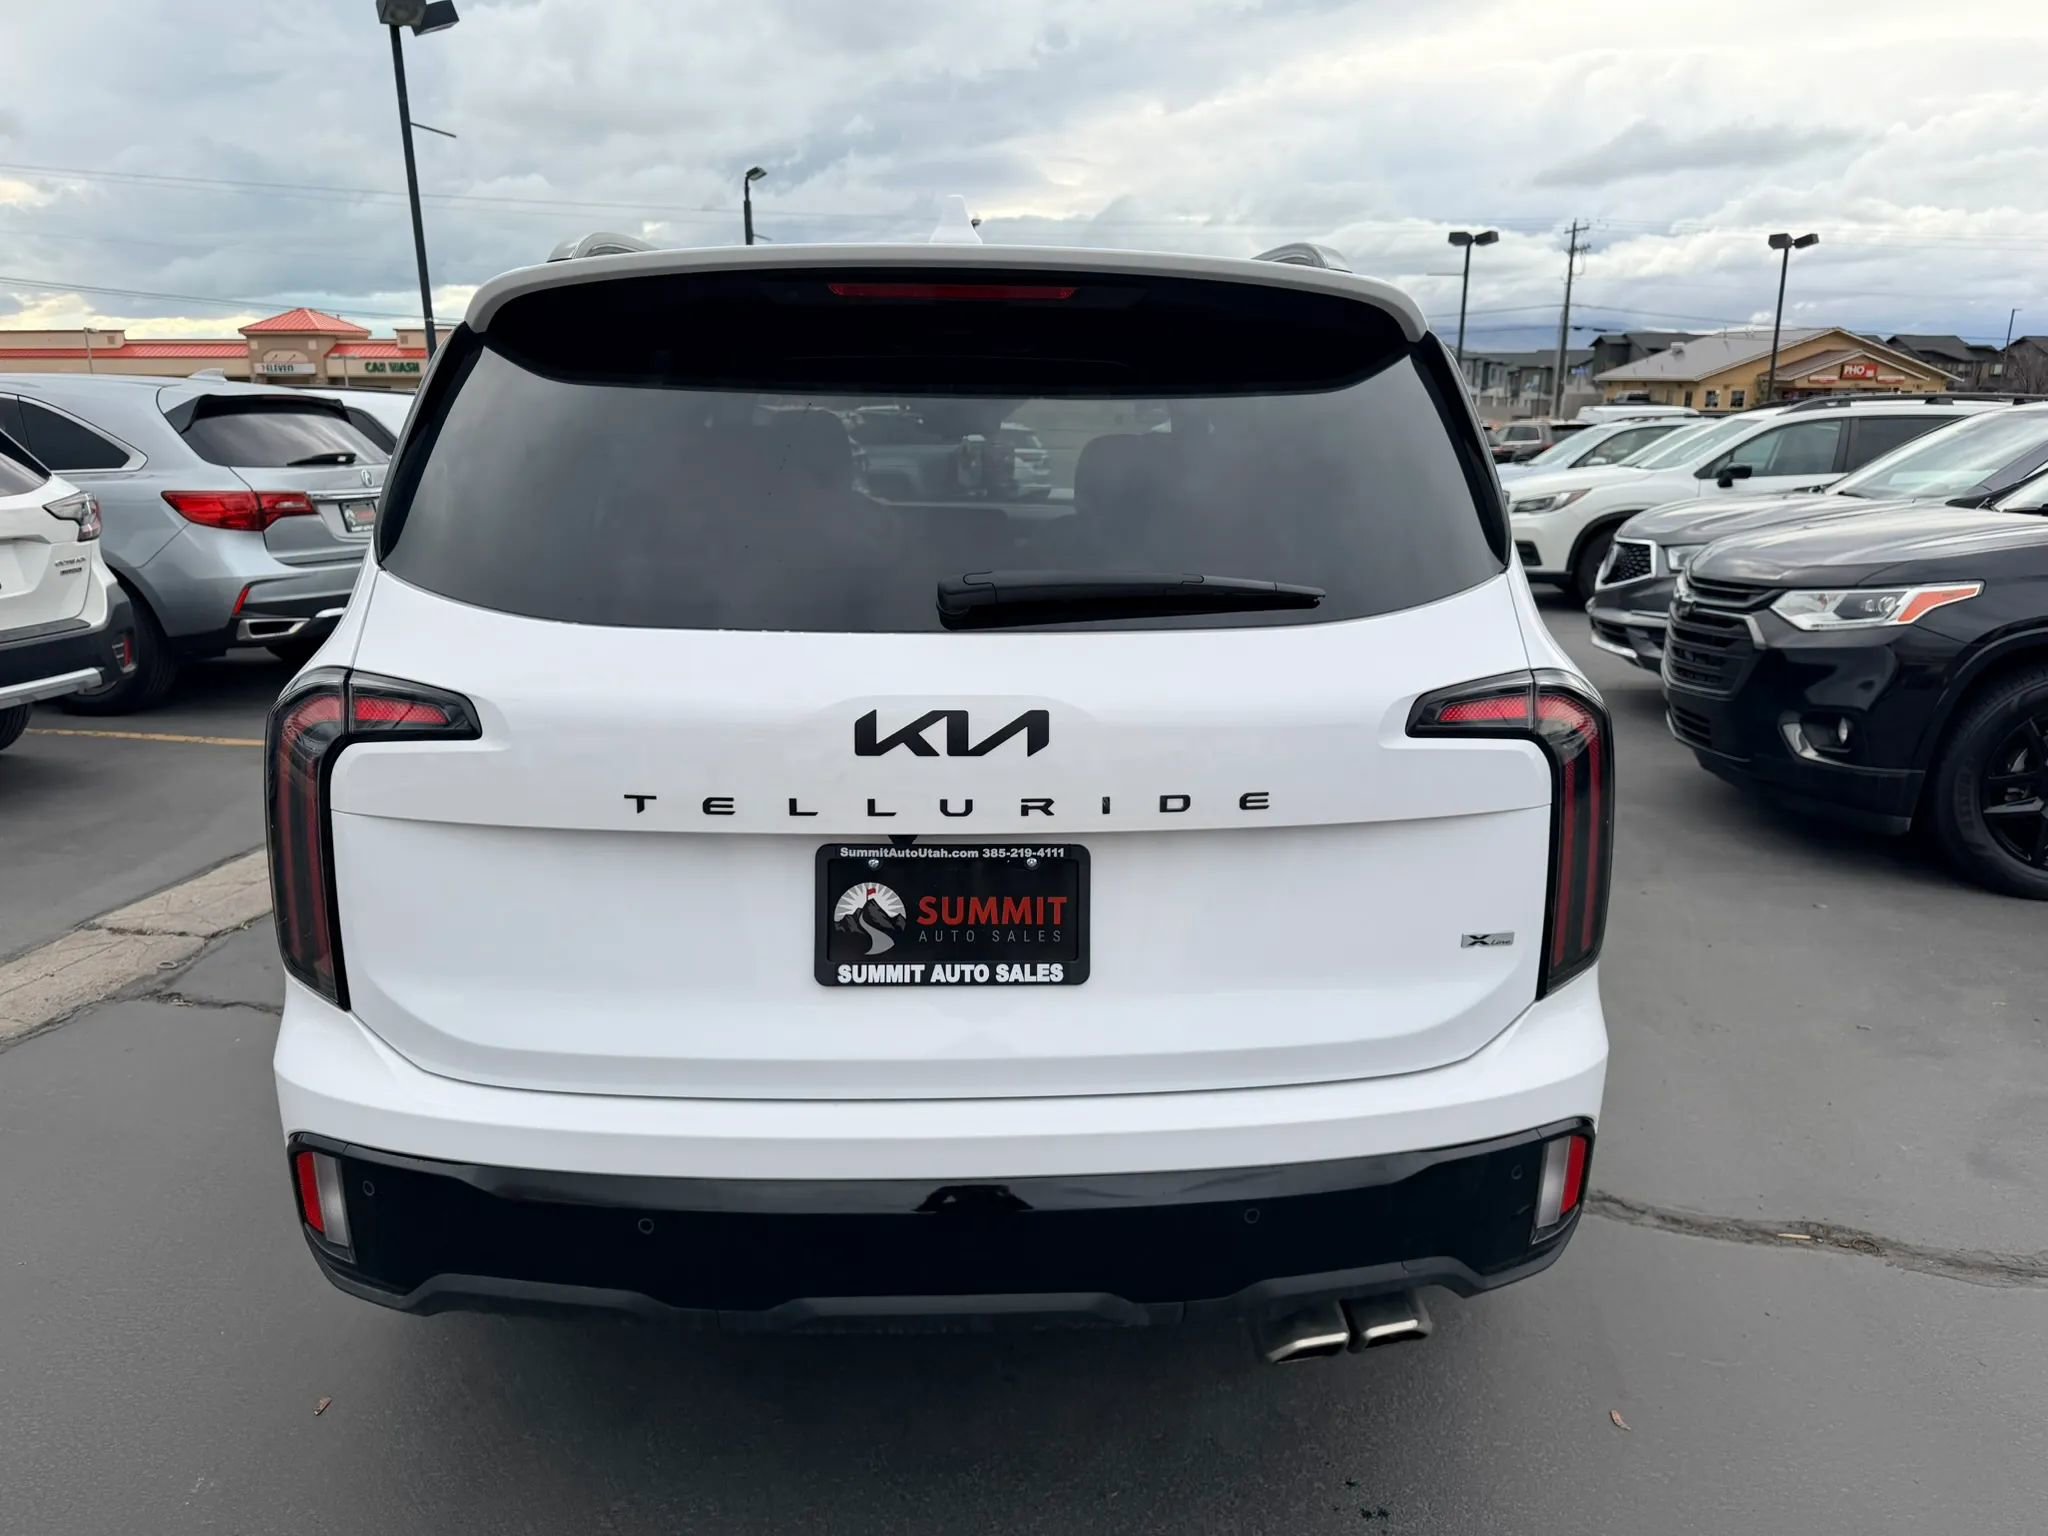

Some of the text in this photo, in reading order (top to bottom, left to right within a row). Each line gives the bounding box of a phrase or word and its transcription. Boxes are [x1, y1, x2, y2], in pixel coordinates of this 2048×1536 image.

[364, 362, 420, 373] CAR WASH
[1844, 365, 1865, 375] PHO
[854, 709, 1049, 757] KIA
[624, 791, 1270, 817] TELLURIDE
[840, 847, 1065, 859] SummitAutoUtah.com 385-219-4111
[916, 896, 1068, 926] SUMMIT
[919, 930, 1062, 943] AUTO SALES
[837, 964, 1064, 984] SUMMIT AUTO SALES
